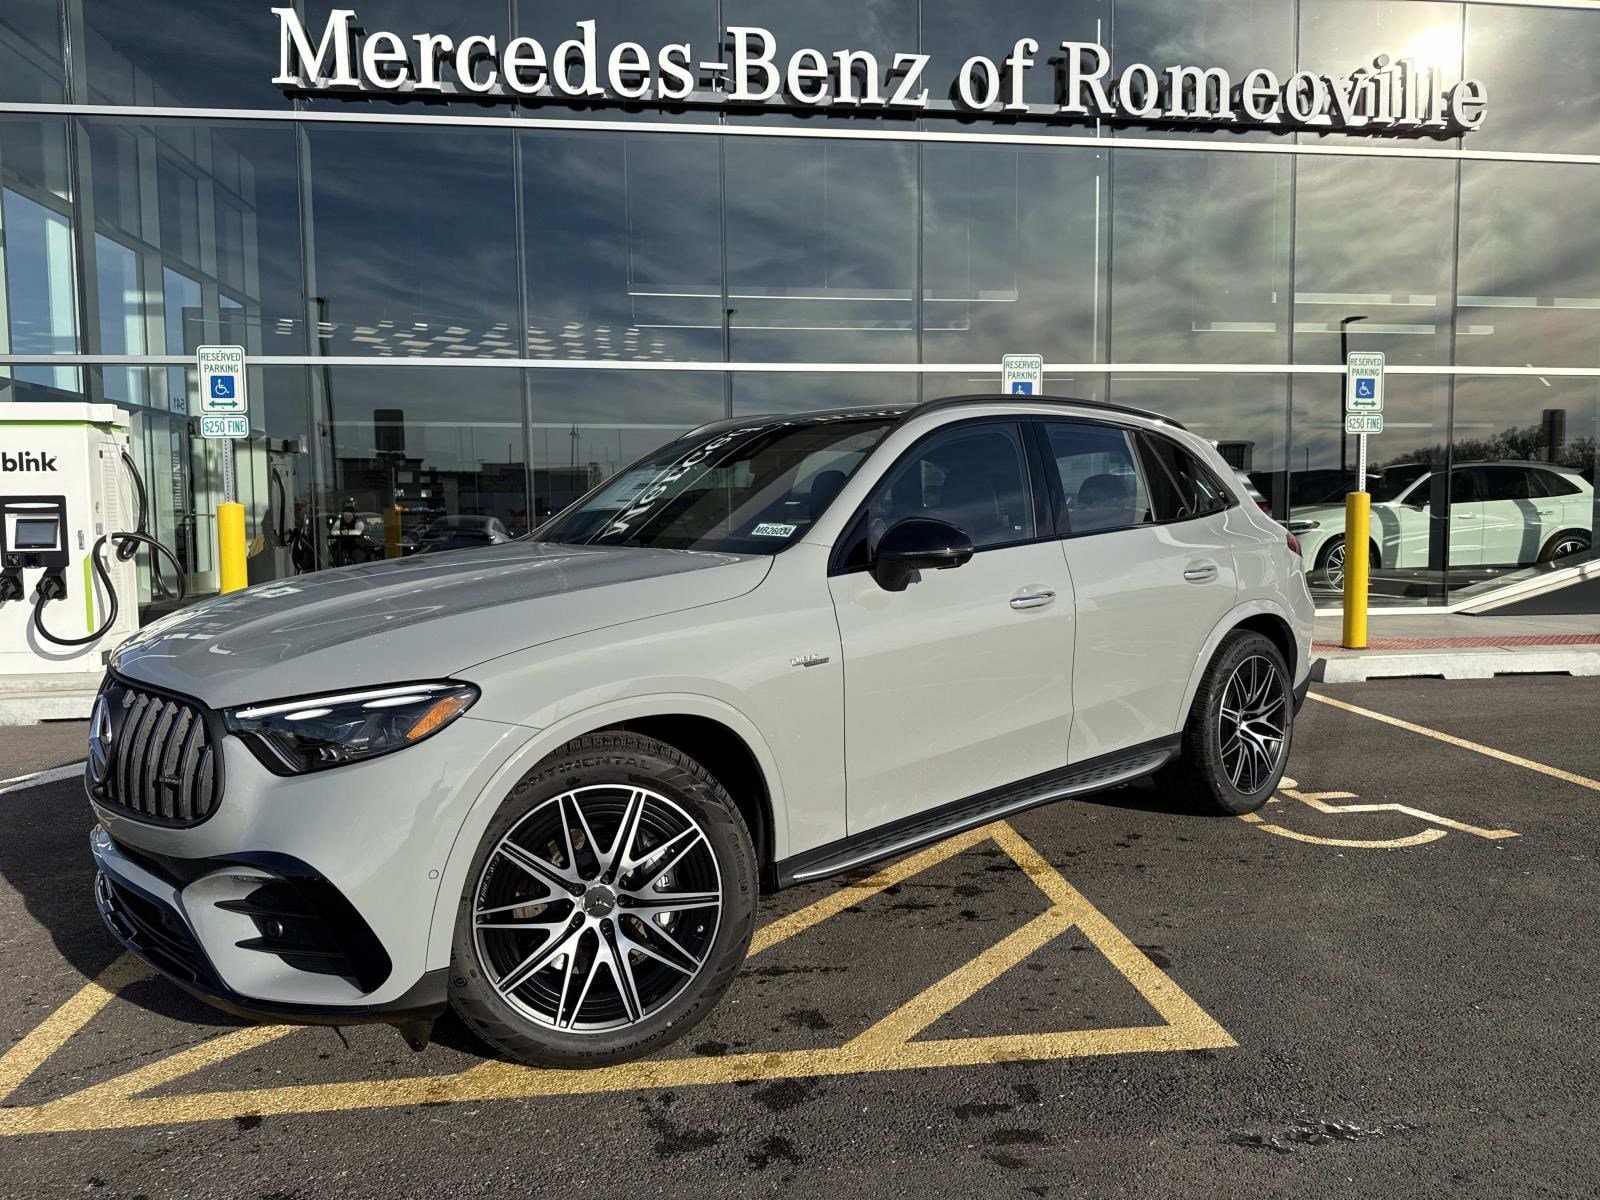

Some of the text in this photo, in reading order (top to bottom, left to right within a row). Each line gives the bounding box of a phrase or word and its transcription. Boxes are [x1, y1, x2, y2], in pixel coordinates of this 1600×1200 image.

[271, 7, 1489, 129] Mercedes-Benz of Romeoville
[200, 352, 241, 362] RESERVED
[1350, 357, 1381, 366] RESERVED
[204, 364, 239, 373] PARKING
[1005, 360, 1040, 369] RESERVED
[1007, 371, 1037, 380] PARKING
[1352, 368, 1380, 377] PARKING
[204, 420, 245, 433] $250 FINE
[1349, 418, 1381, 430] $250 FINE
[1, 450, 58, 472] blink
